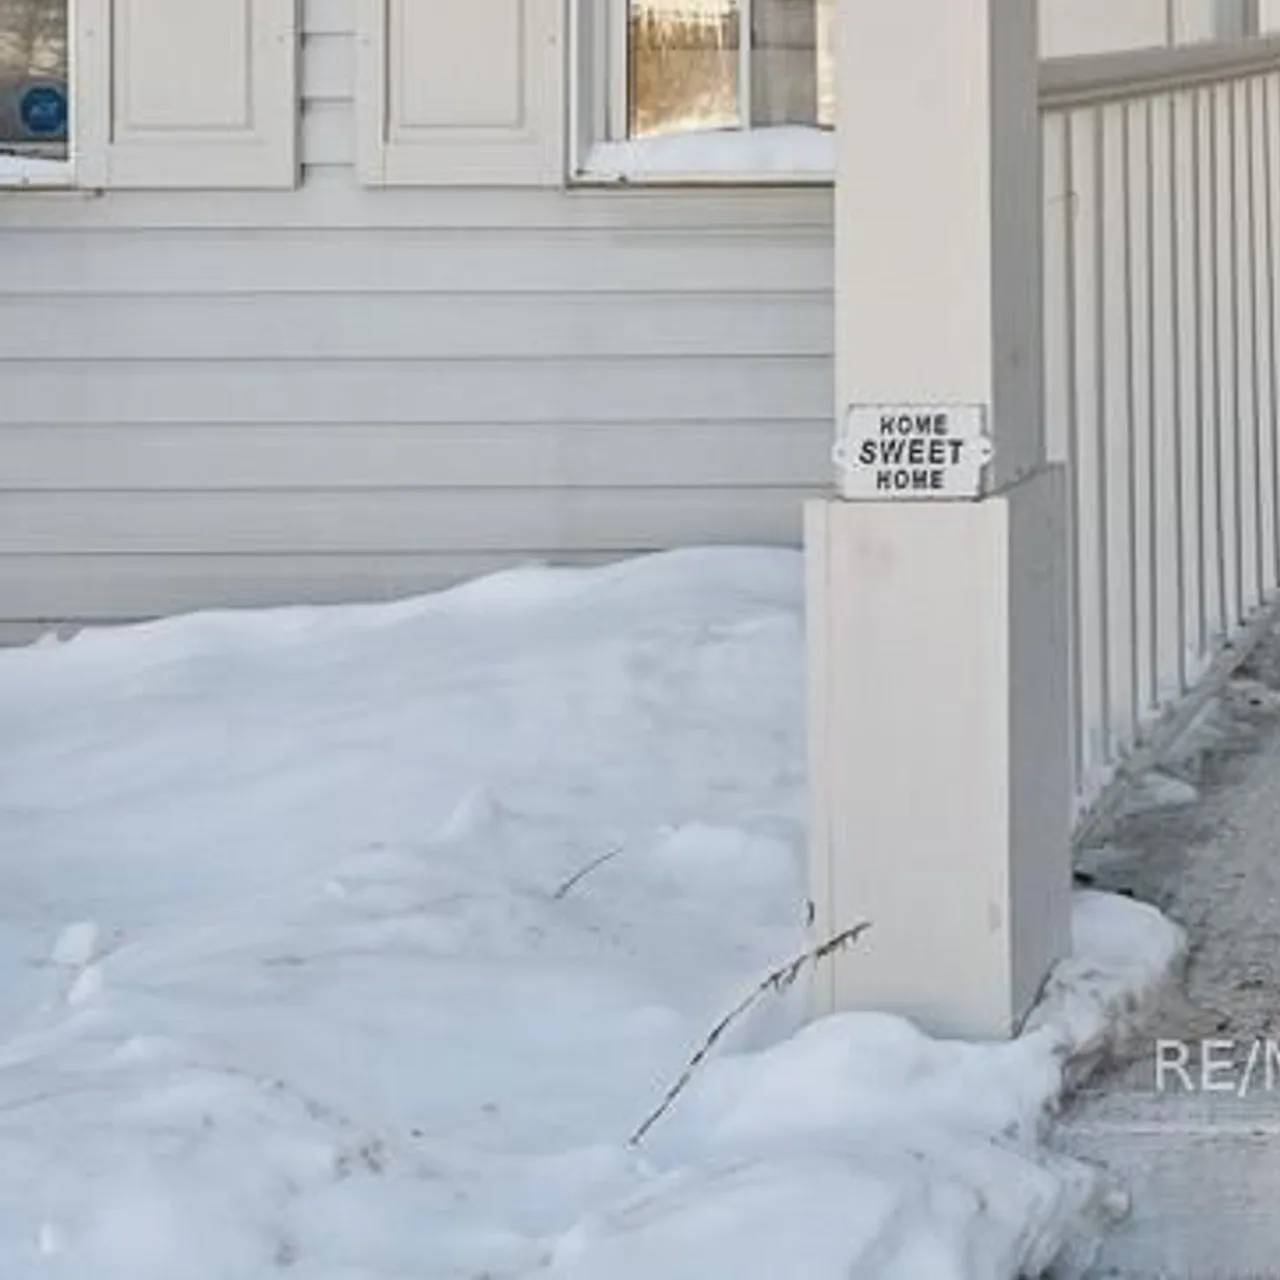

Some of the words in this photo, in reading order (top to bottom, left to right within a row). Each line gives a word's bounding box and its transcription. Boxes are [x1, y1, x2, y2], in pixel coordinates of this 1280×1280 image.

[880, 414, 949, 436] HOME
[859, 438, 963, 465] SWEET
[876, 470, 944, 490] HOME
